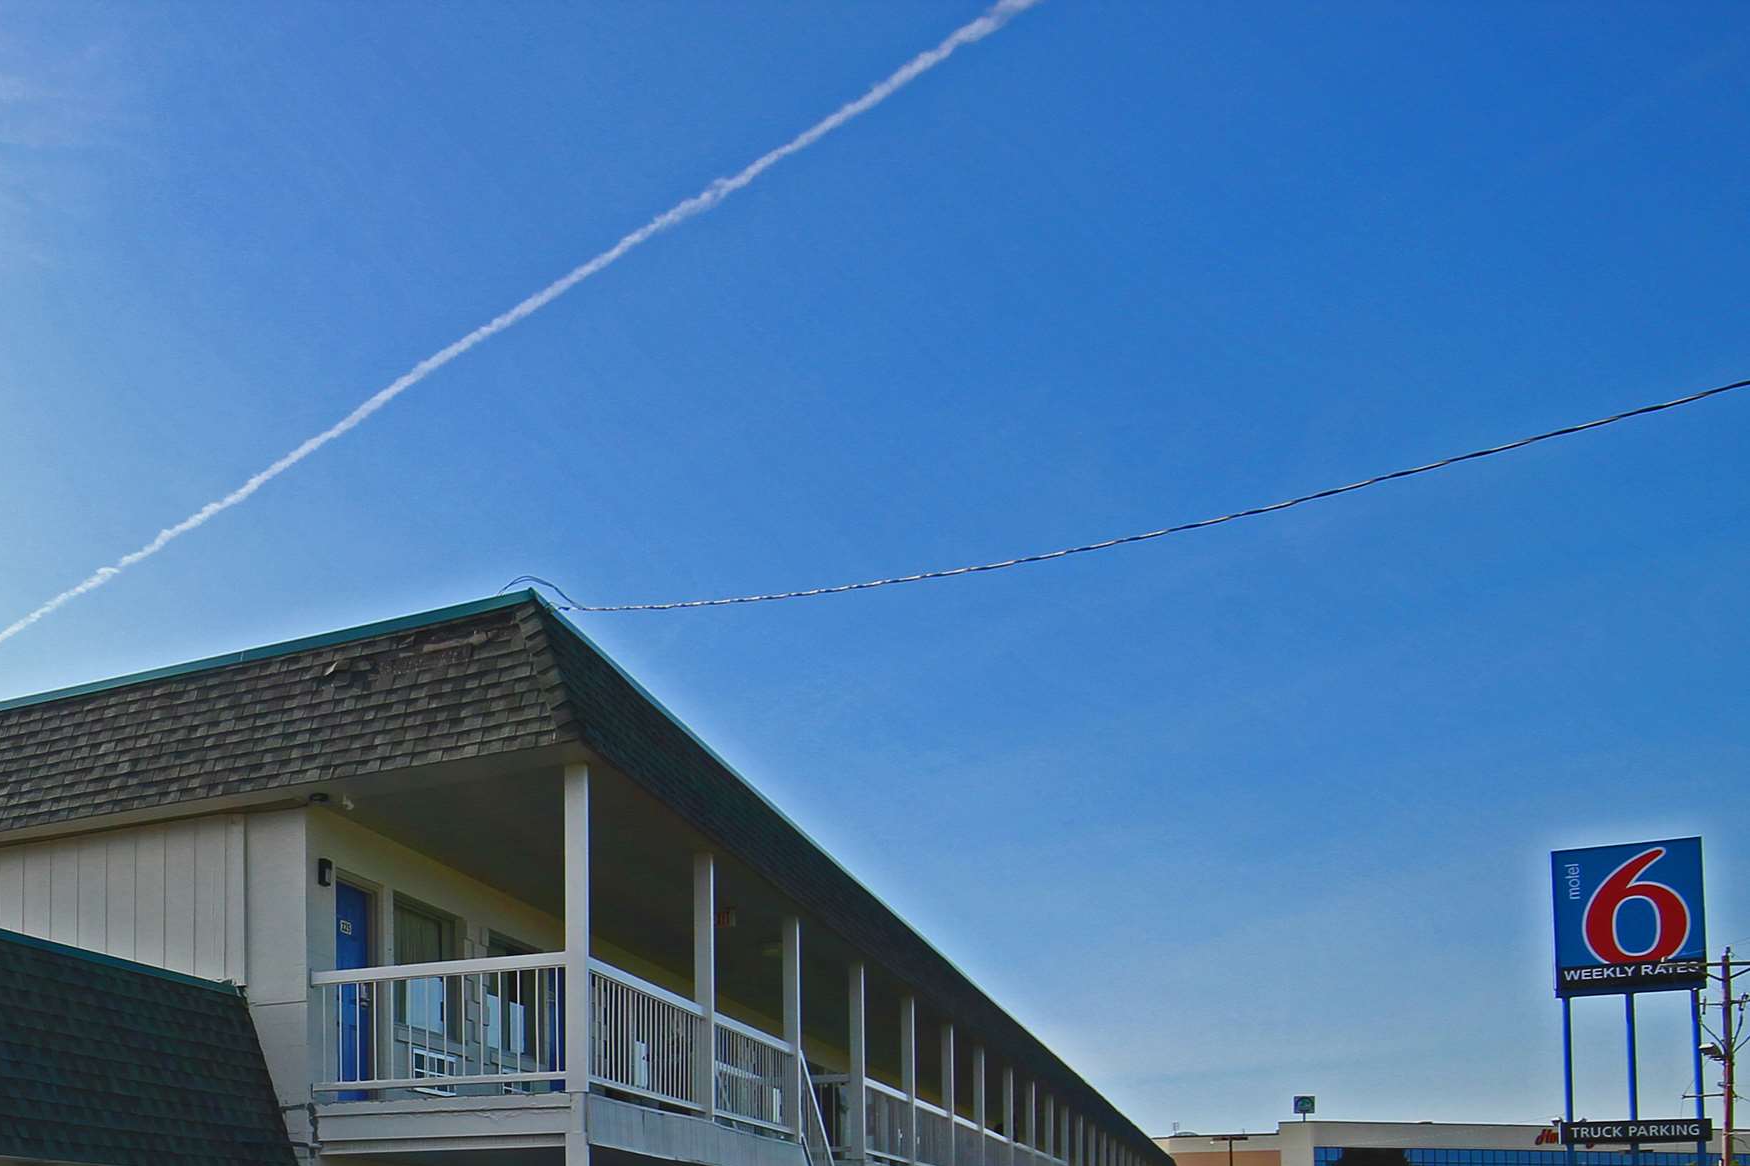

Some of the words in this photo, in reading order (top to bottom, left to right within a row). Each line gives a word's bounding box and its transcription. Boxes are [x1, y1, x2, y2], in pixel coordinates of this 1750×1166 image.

[1565, 863, 1581, 900] motel
[1582, 847, 1691, 964] 6
[1564, 965, 1636, 981] WEEKLY
[1641, 961, 1699, 976] RATES
[1570, 1126, 1623, 1139] TRUCK
[1628, 1123, 1701, 1138] PARKING
